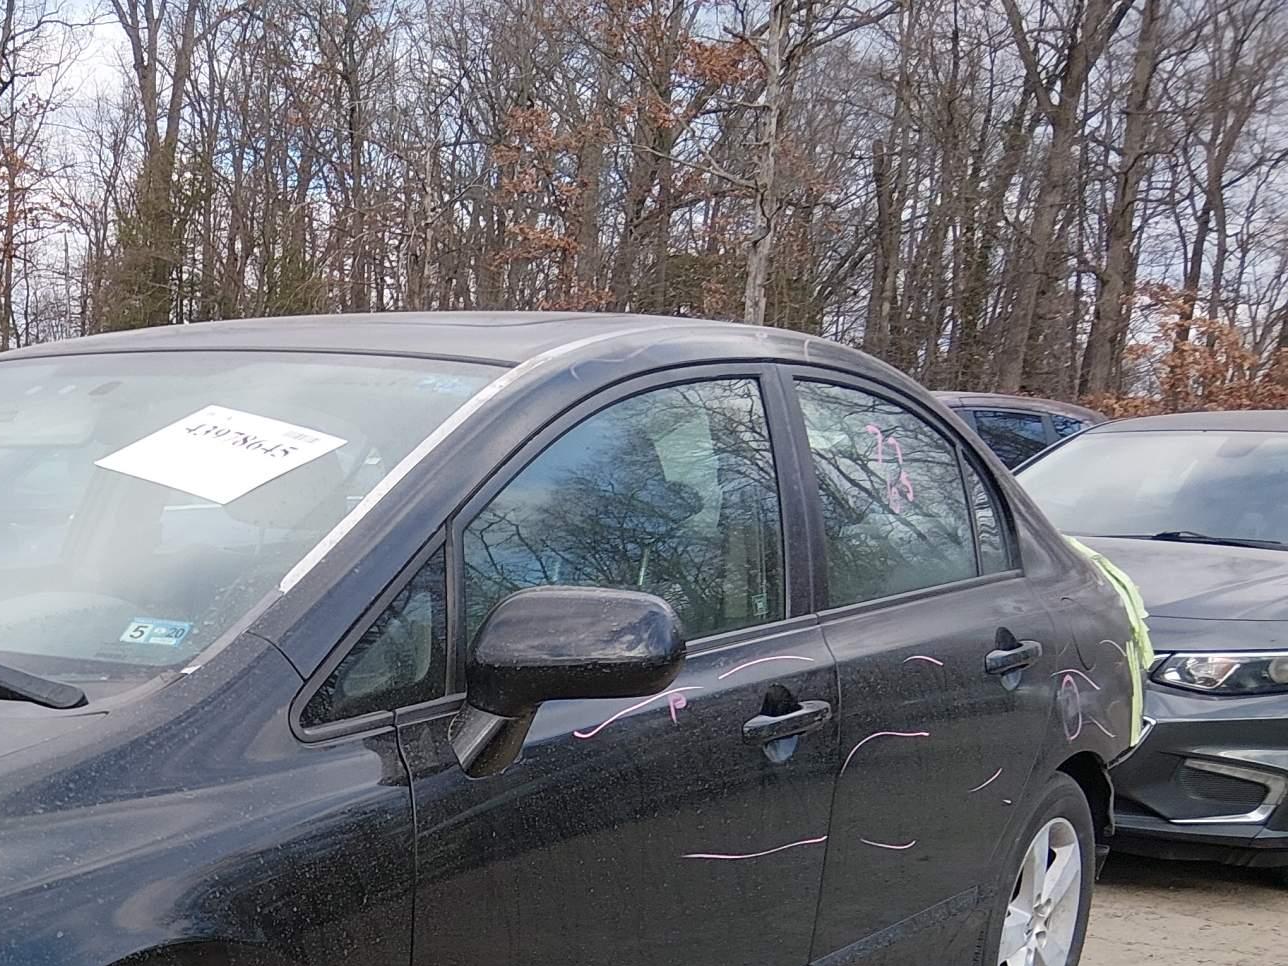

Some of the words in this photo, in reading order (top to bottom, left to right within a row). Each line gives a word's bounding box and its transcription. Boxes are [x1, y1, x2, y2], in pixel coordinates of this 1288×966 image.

[185, 423, 299, 458] 43978645
[129, 625, 149, 639] 5
[166, 627, 185, 639] 20
